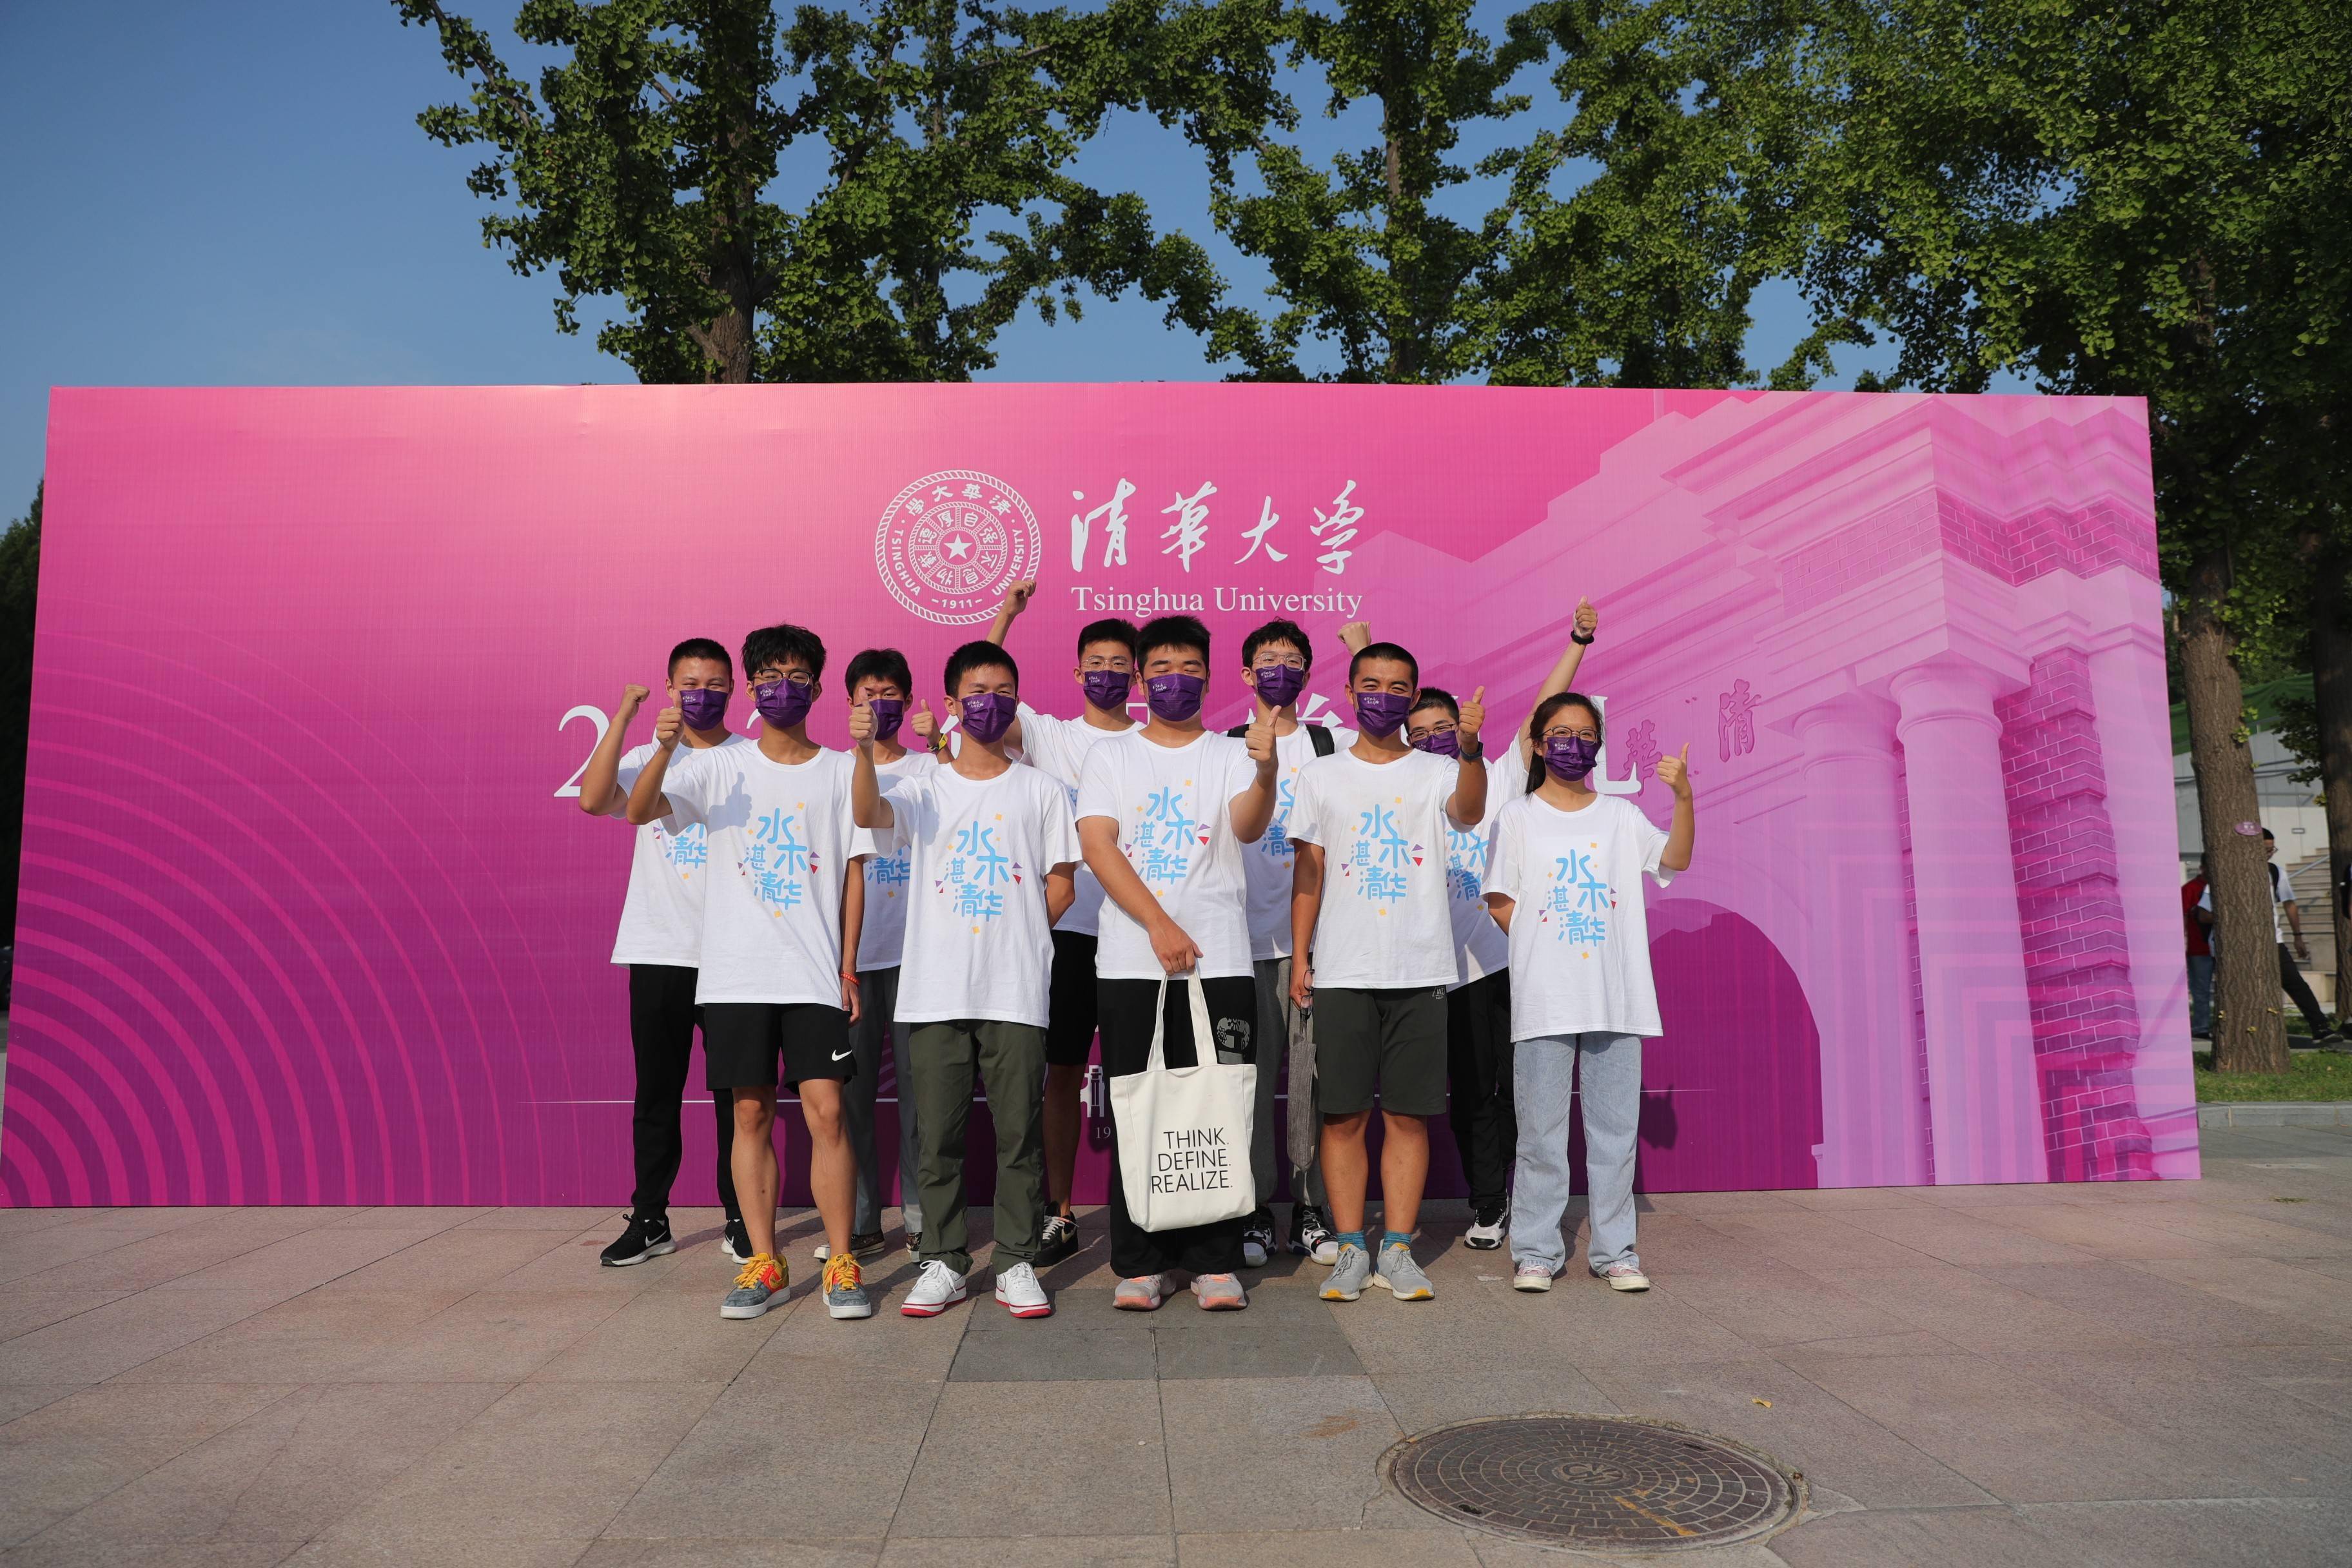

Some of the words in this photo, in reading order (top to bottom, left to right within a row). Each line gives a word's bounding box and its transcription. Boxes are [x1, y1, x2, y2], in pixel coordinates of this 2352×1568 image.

[892, 529, 921, 596] TSINGHUA
[991, 529, 1025, 596] UNIVERSITY
[1071, 587, 1204, 618] Tsinghua
[1213, 587, 1363, 619] University
[1163, 1127, 1230, 1150] THINK.
[1158, 1148, 1231, 1171] DEFINE.
[1151, 1170, 1233, 1194] REALIZE.
